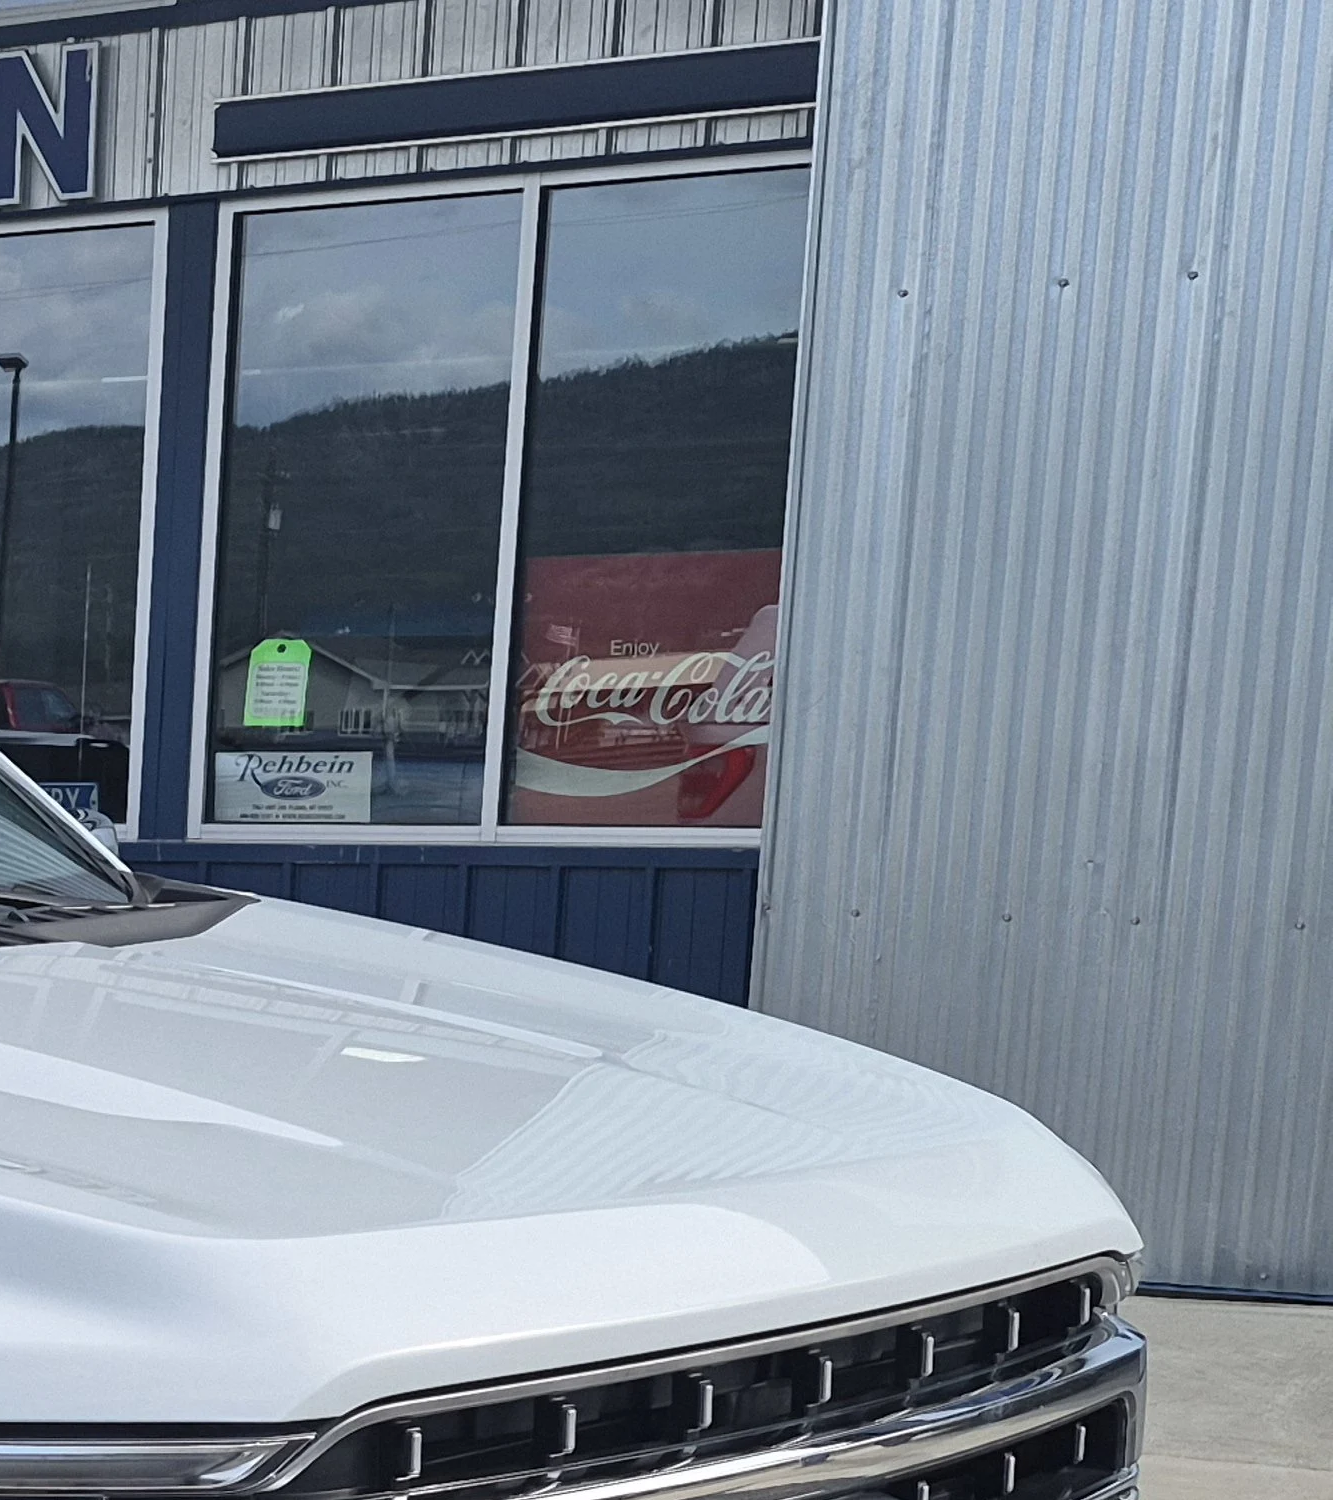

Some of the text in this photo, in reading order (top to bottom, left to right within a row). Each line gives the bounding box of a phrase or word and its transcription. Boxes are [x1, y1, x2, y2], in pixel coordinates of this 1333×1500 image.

[609, 638, 660, 658] Enjoy
[535, 651, 775, 727] Coca-Cola
[235, 753, 355, 788] Rehbein
[272, 778, 313, 797] Ford
